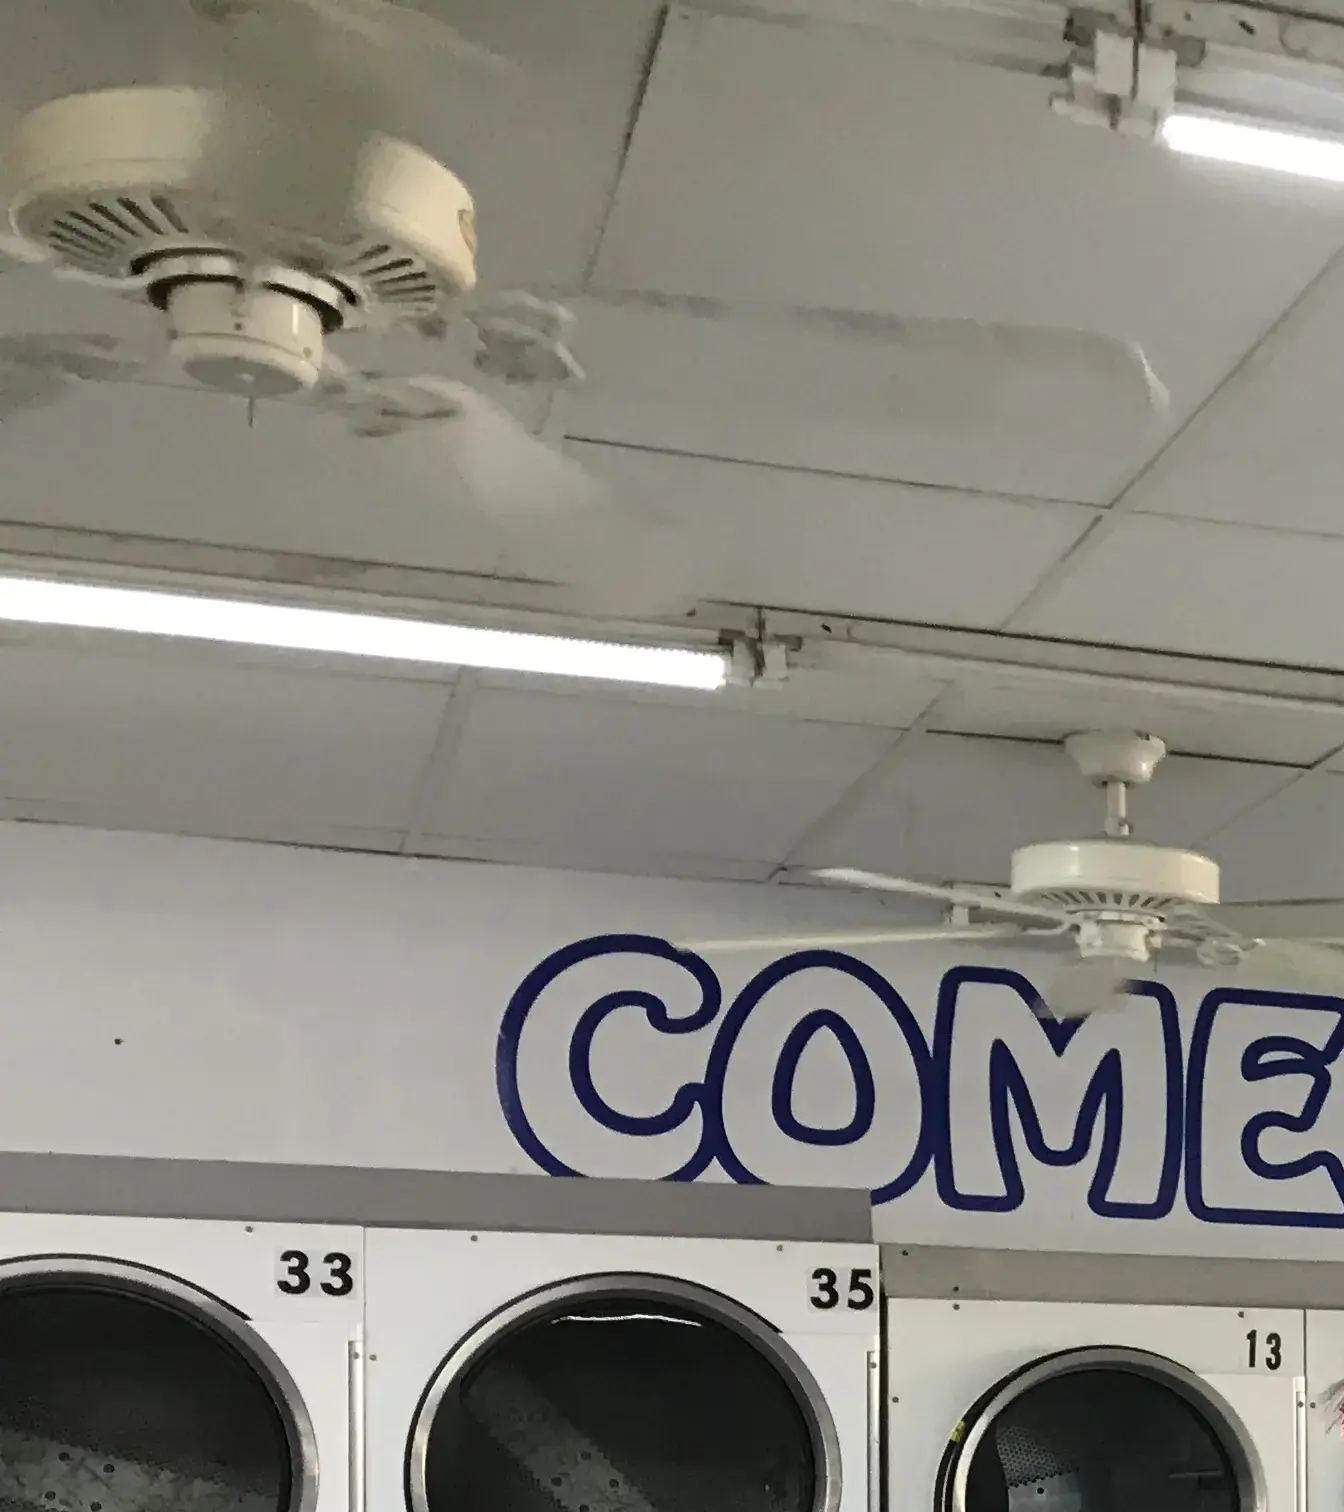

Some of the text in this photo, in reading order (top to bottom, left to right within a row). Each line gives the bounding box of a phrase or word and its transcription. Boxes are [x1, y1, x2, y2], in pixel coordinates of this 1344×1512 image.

[278, 1251, 353, 1296] 33
[811, 1268, 874, 1310] 35
[1246, 1329, 1282, 1371] 13
